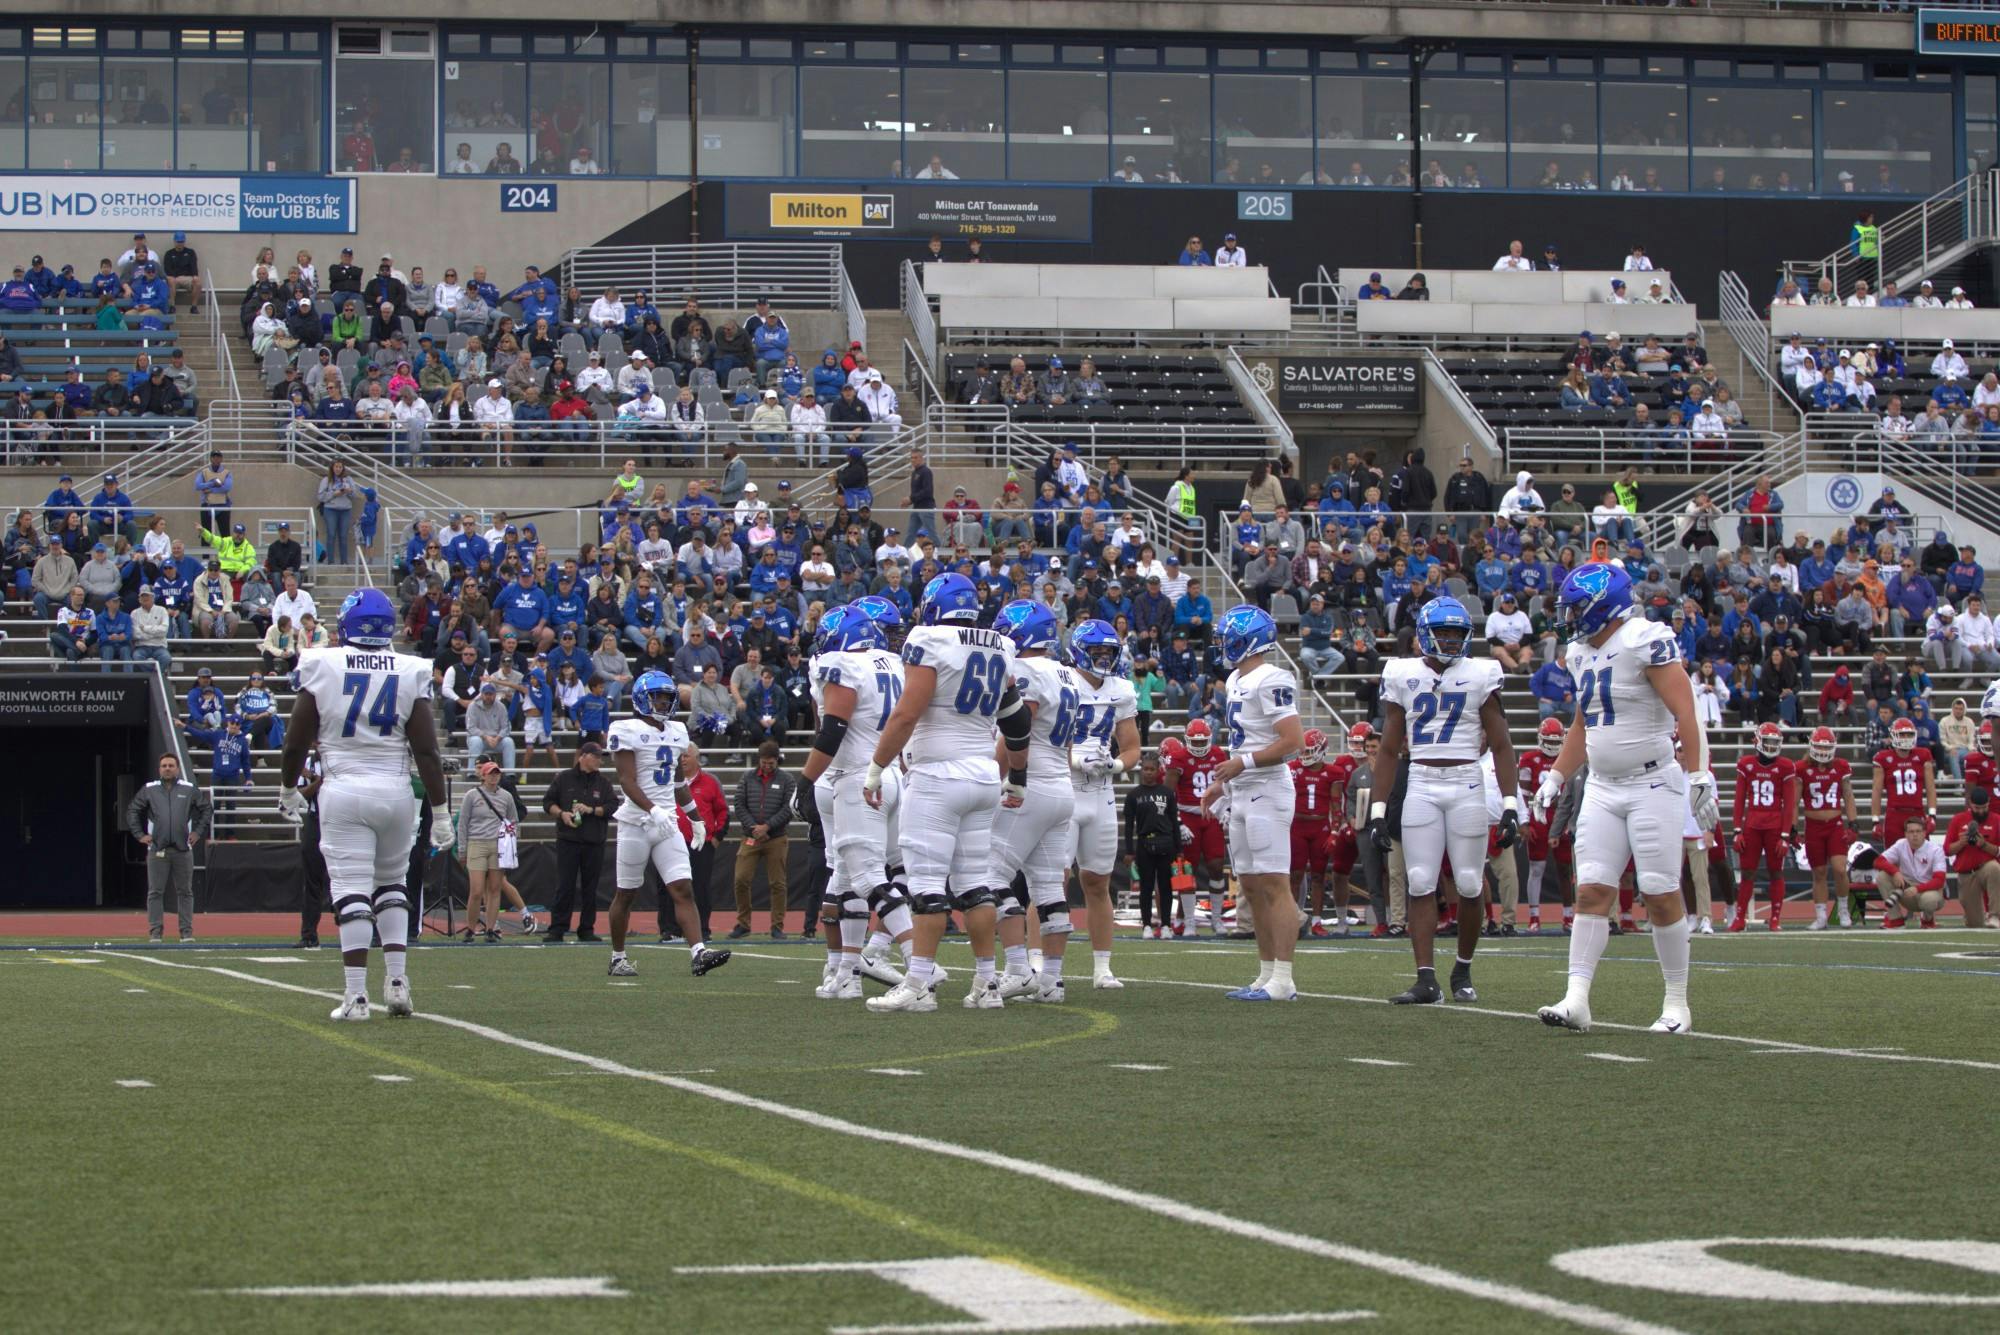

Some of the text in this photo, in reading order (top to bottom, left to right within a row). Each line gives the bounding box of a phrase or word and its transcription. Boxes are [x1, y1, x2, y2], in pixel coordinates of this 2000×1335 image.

[0, 192, 97, 216] UB MD
[101, 193, 235, 206] ORTHOPAEDICS
[243, 193, 340, 205] Team Doctors for
[507, 187, 550, 208] 204
[936, 201, 1039, 211] Milton CAT Tonawanda
[1244, 196, 1286, 216] 205
[101, 207, 235, 218] & SPORTS MEDICINE
[244, 205, 340, 220] Your UB Bulls
[787, 202, 890, 219] Milton CAT
[930, 213, 959, 221] Wheeler
[961, 213, 983, 221] Street,
[985, 214, 1025, 222] Tonawanda,
[959, 224, 1016, 234] 716-799-1320
[1284, 366, 1416, 382] SALVATORE'S
[1651, 640, 1677, 664] 21
[346, 654, 396, 671] WRIGHT
[818, 666, 842, 685] 78
[954, 651, 1006, 717] 69
[81, 691, 126, 701] FAMILY
[341, 672, 400, 738] 74
[1272, 687, 1293, 707] 15
[1580, 666, 1615, 728] 21
[0, 705, 115, 713] FOOTBALL LOCKER ROOM
[1072, 703, 1117, 747] 34
[1412, 692, 1468, 746] 27
[609, 734, 620, 751] 3
[652, 745, 674, 786] 3
[1893, 769, 1918, 796] 18
[1137, 795, 1167, 804] MIAMI
[1306, 784, 1316, 810] 1
[1751, 780, 1775, 807] 19
[1809, 782, 1838, 809] 54
